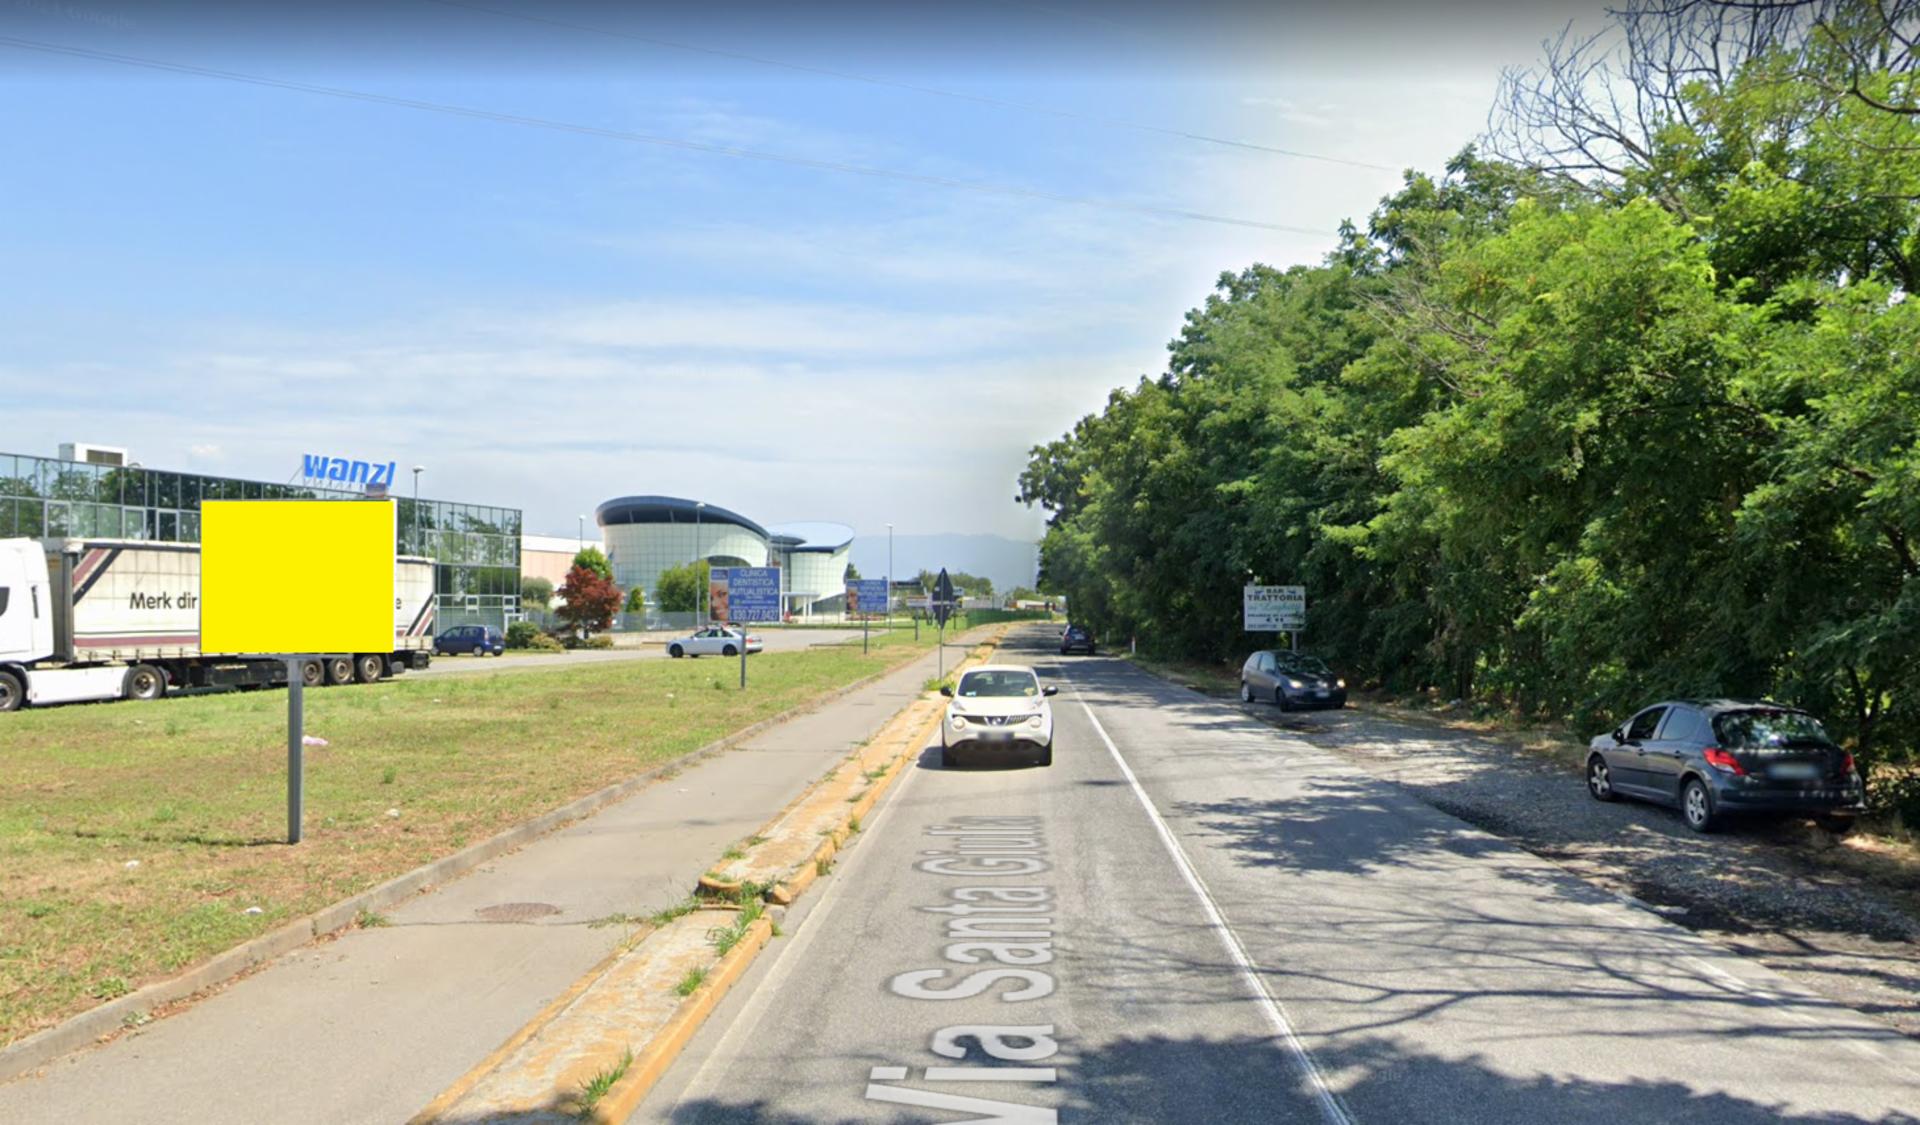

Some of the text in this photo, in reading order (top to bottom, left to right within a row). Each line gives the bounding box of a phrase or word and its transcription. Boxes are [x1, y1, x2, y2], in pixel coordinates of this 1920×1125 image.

[739, 569, 768, 577] CLINICA
[733, 578, 774, 586] DENTISTICA
[130, 591, 197, 610] Merk dir
